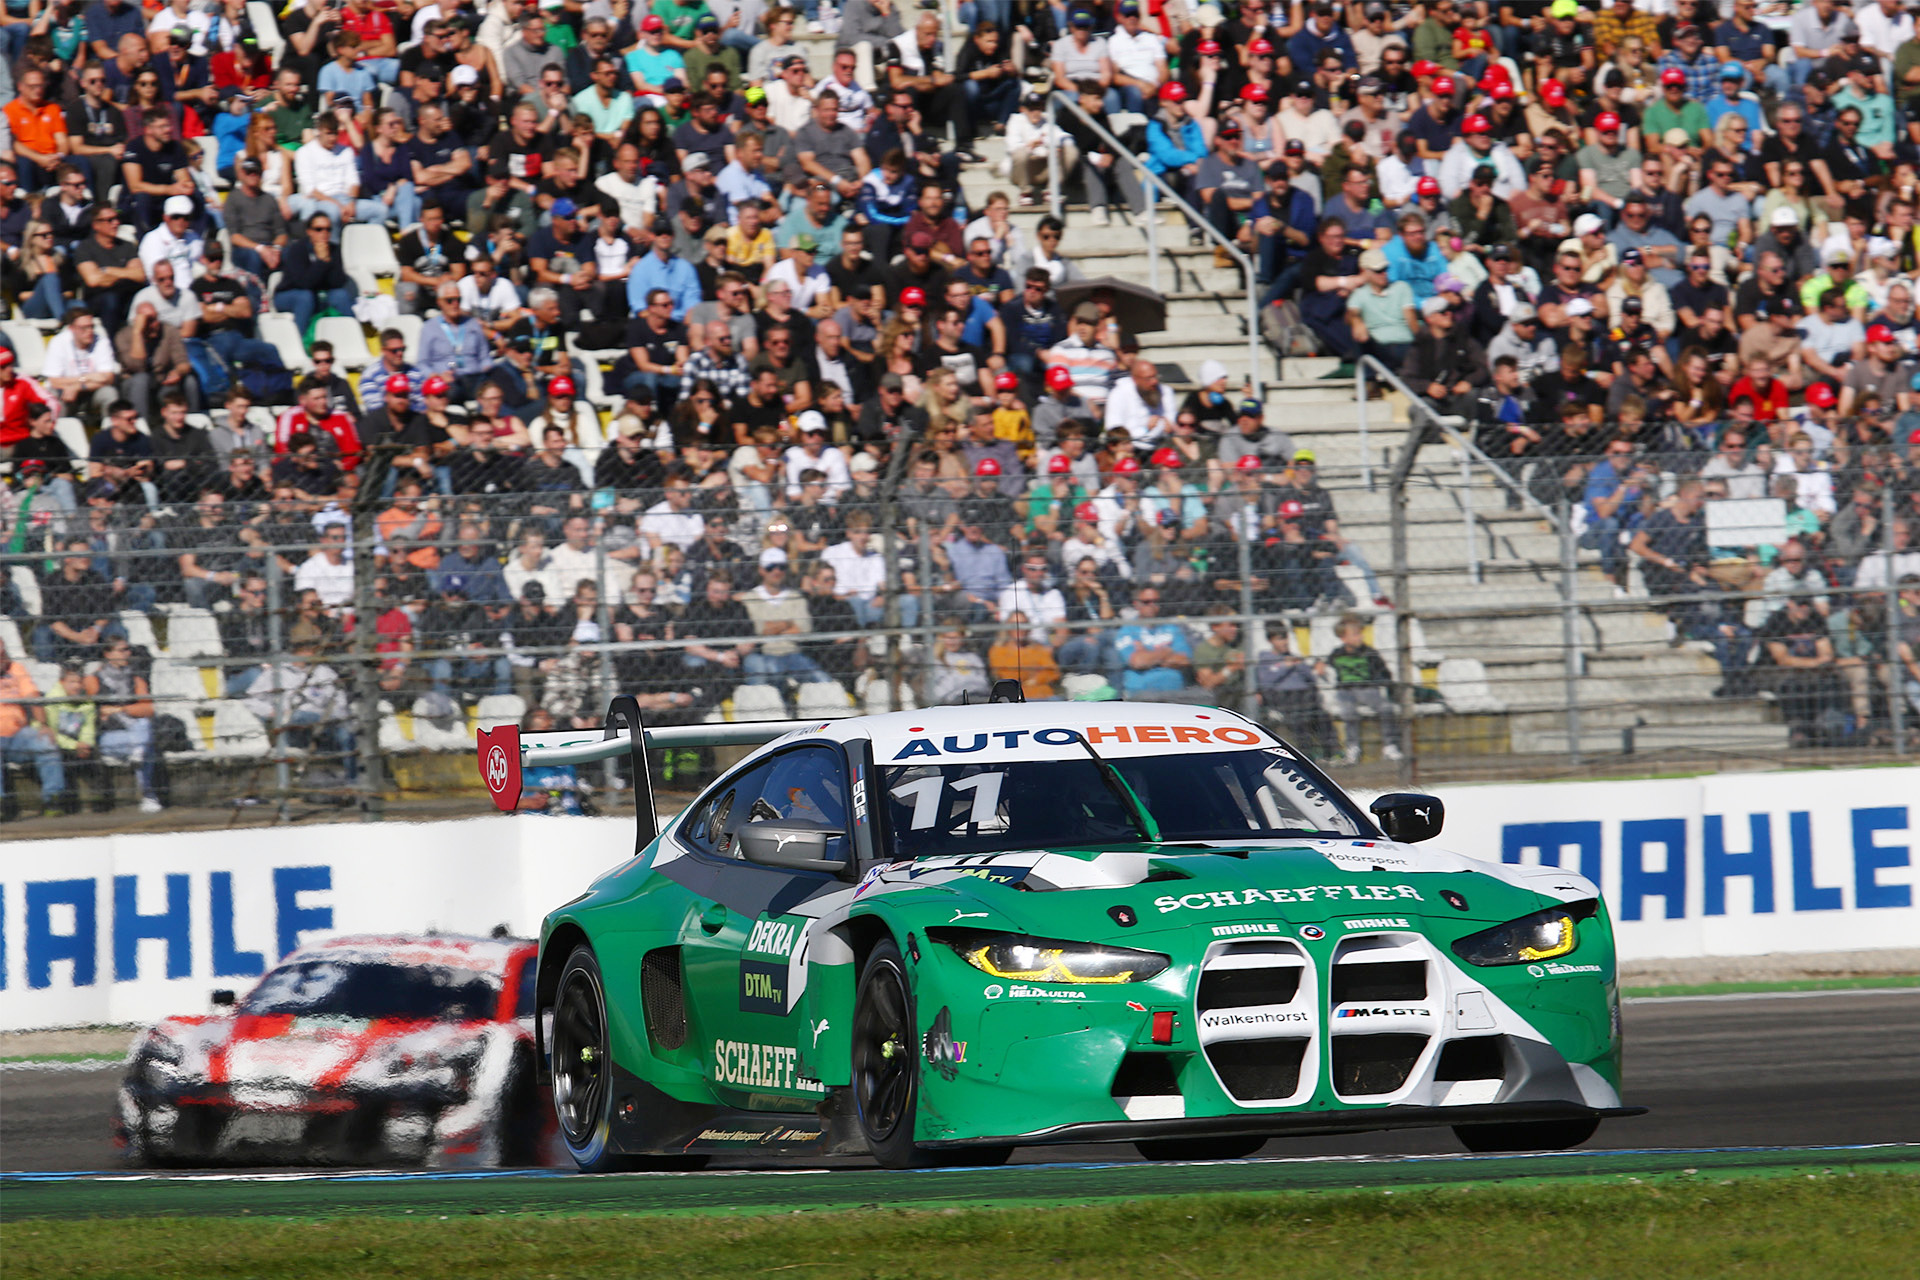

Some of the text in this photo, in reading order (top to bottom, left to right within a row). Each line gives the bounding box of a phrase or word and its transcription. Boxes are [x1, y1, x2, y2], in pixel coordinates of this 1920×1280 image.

[891, 726, 1261, 760] AUTOHERO
[889, 771, 1004, 831] 11
[1154, 885, 1425, 914] SCHAEFFLER
[0, 865, 334, 991] AHLE
[747, 920, 795, 956] DEKRA
[1212, 923, 1280, 936] MAHLE
[1343, 918, 1411, 930] MAHLE
[1203, 1012, 1308, 1028] Walkenhorst
[715, 1039, 825, 1093] SCHAEFF
